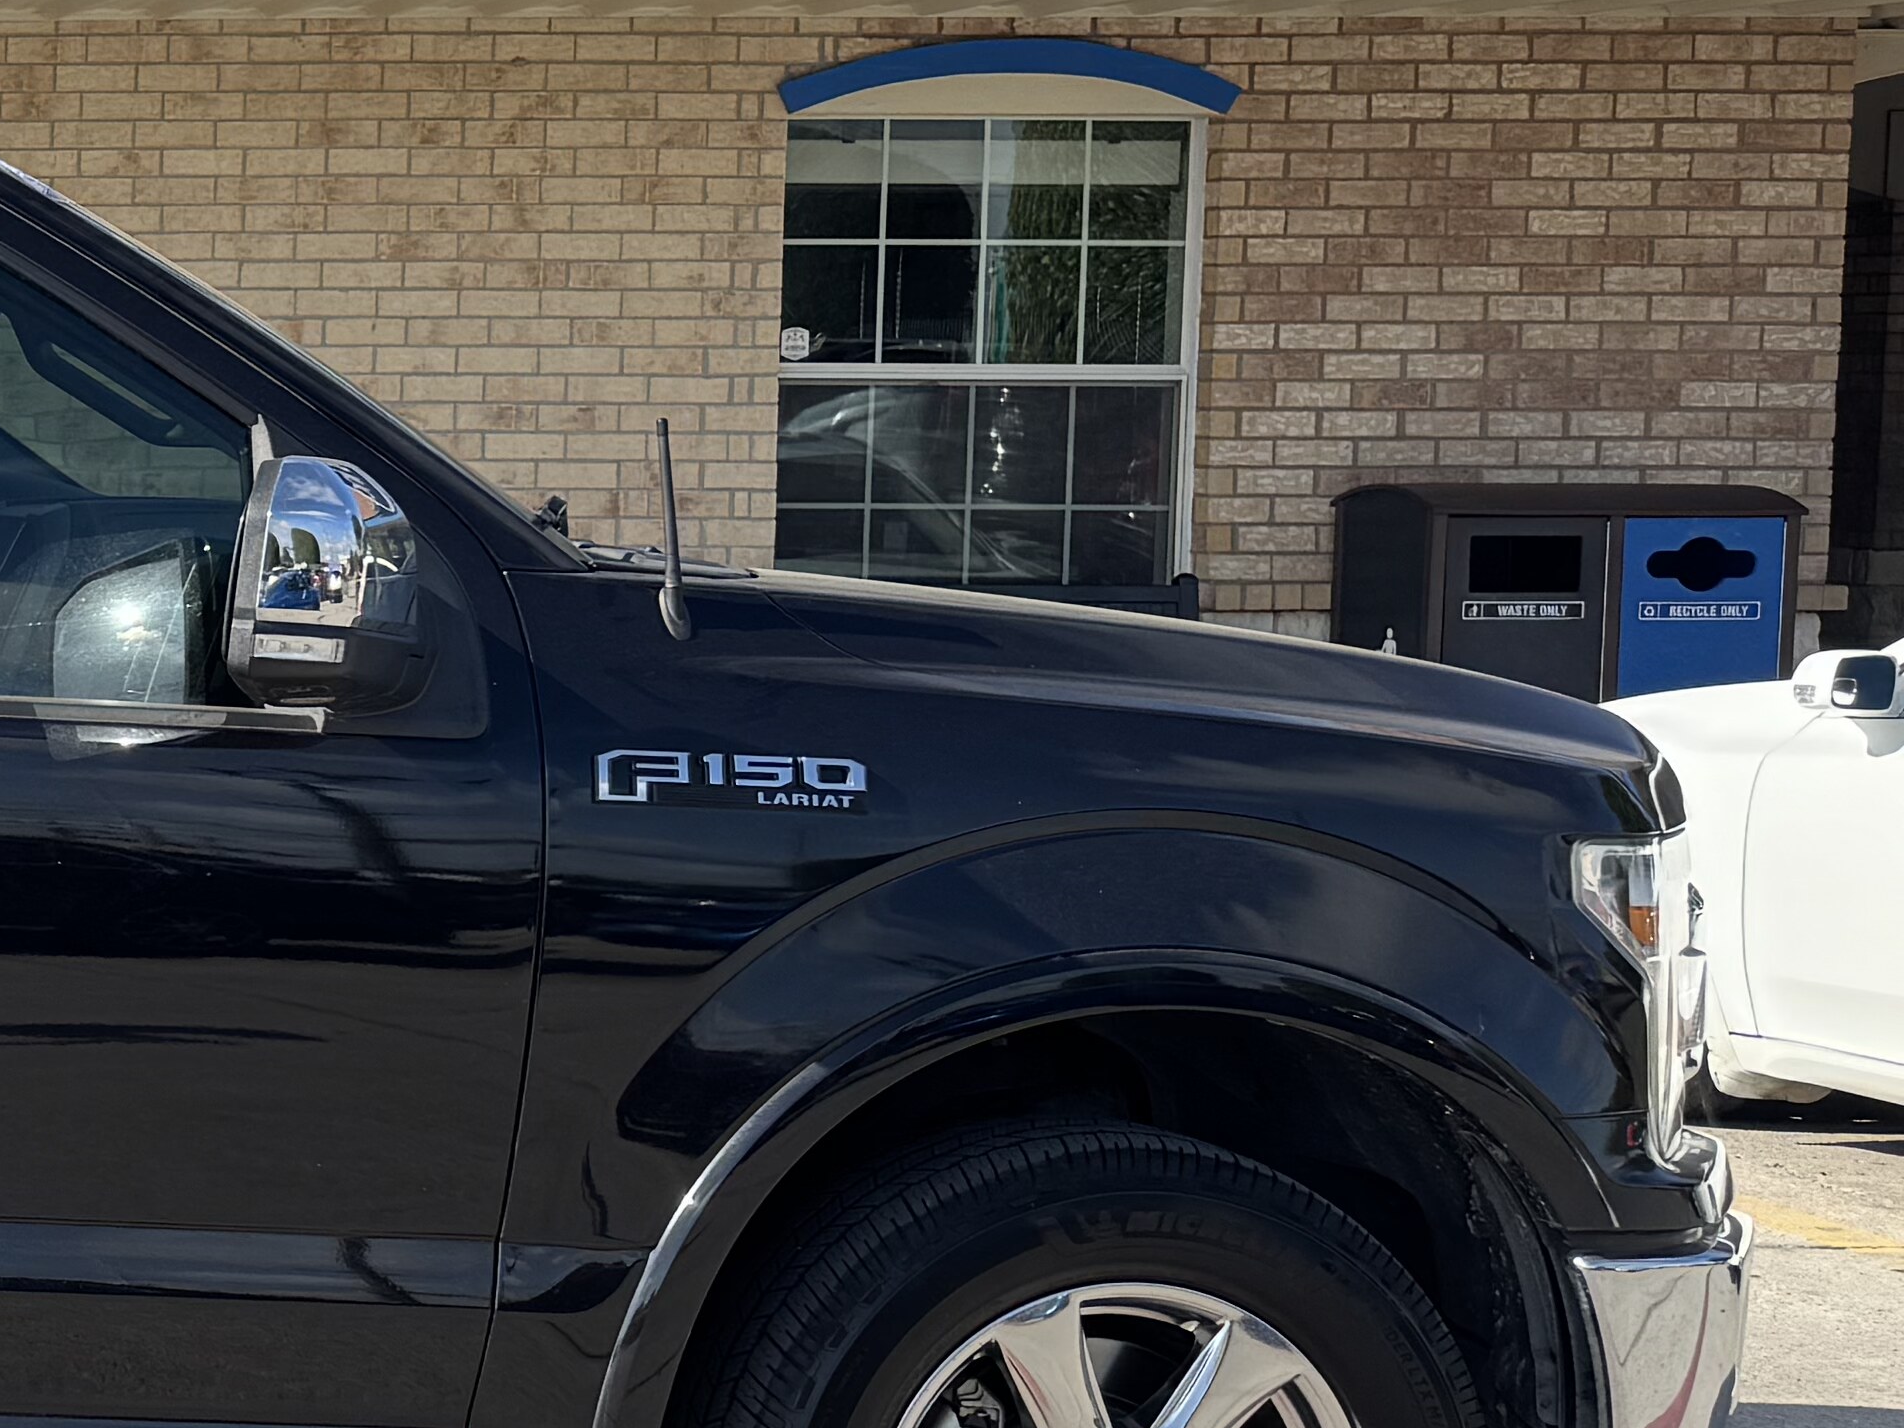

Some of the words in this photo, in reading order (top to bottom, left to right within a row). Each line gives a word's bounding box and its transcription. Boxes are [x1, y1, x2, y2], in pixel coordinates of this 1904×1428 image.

[1496, 605, 1537, 618] WASTE
[1539, 605, 1569, 618] ONLY
[1668, 605, 1718, 618] RECYCLE
[1720, 605, 1750, 618] ONLY
[756, 790, 856, 810] LARIAT
